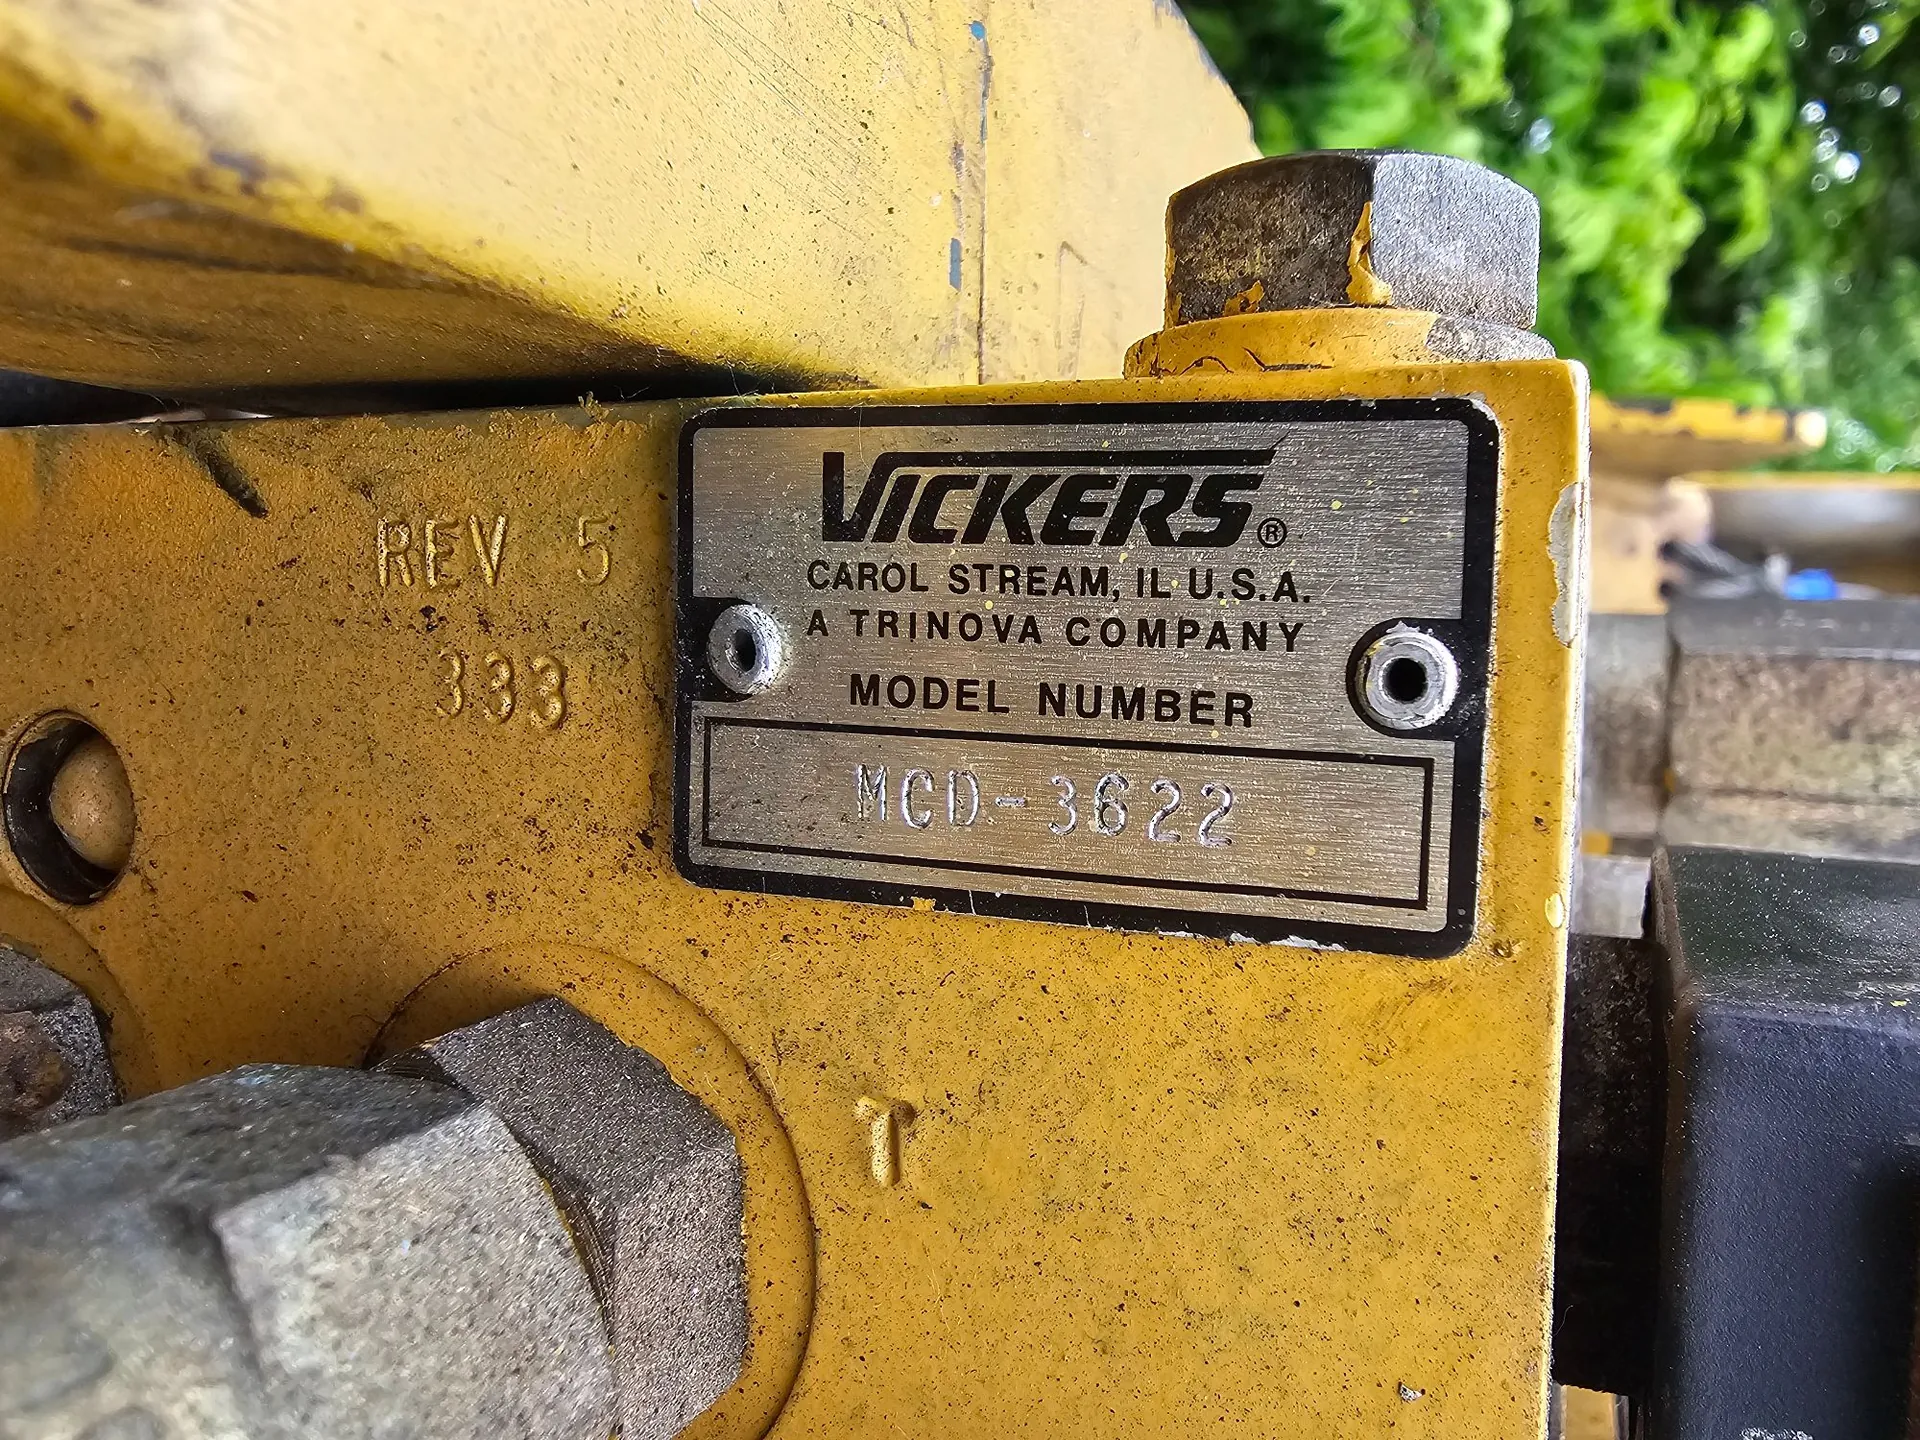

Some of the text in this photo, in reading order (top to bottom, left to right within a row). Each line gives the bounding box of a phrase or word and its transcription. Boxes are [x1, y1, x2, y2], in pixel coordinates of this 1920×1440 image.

[822, 450, 1275, 548] VICKERS
[376, 513, 611, 590] REV 5
[806, 560, 1312, 604] CAROL STREAM, IL U.S.A.
[806, 609, 1304, 653] A TRINOVA COMPANY
[433, 648, 567, 730] 333
[849, 674, 1256, 728] MODEL NUMBER
[854, 763, 1236, 847] MCD-3622
